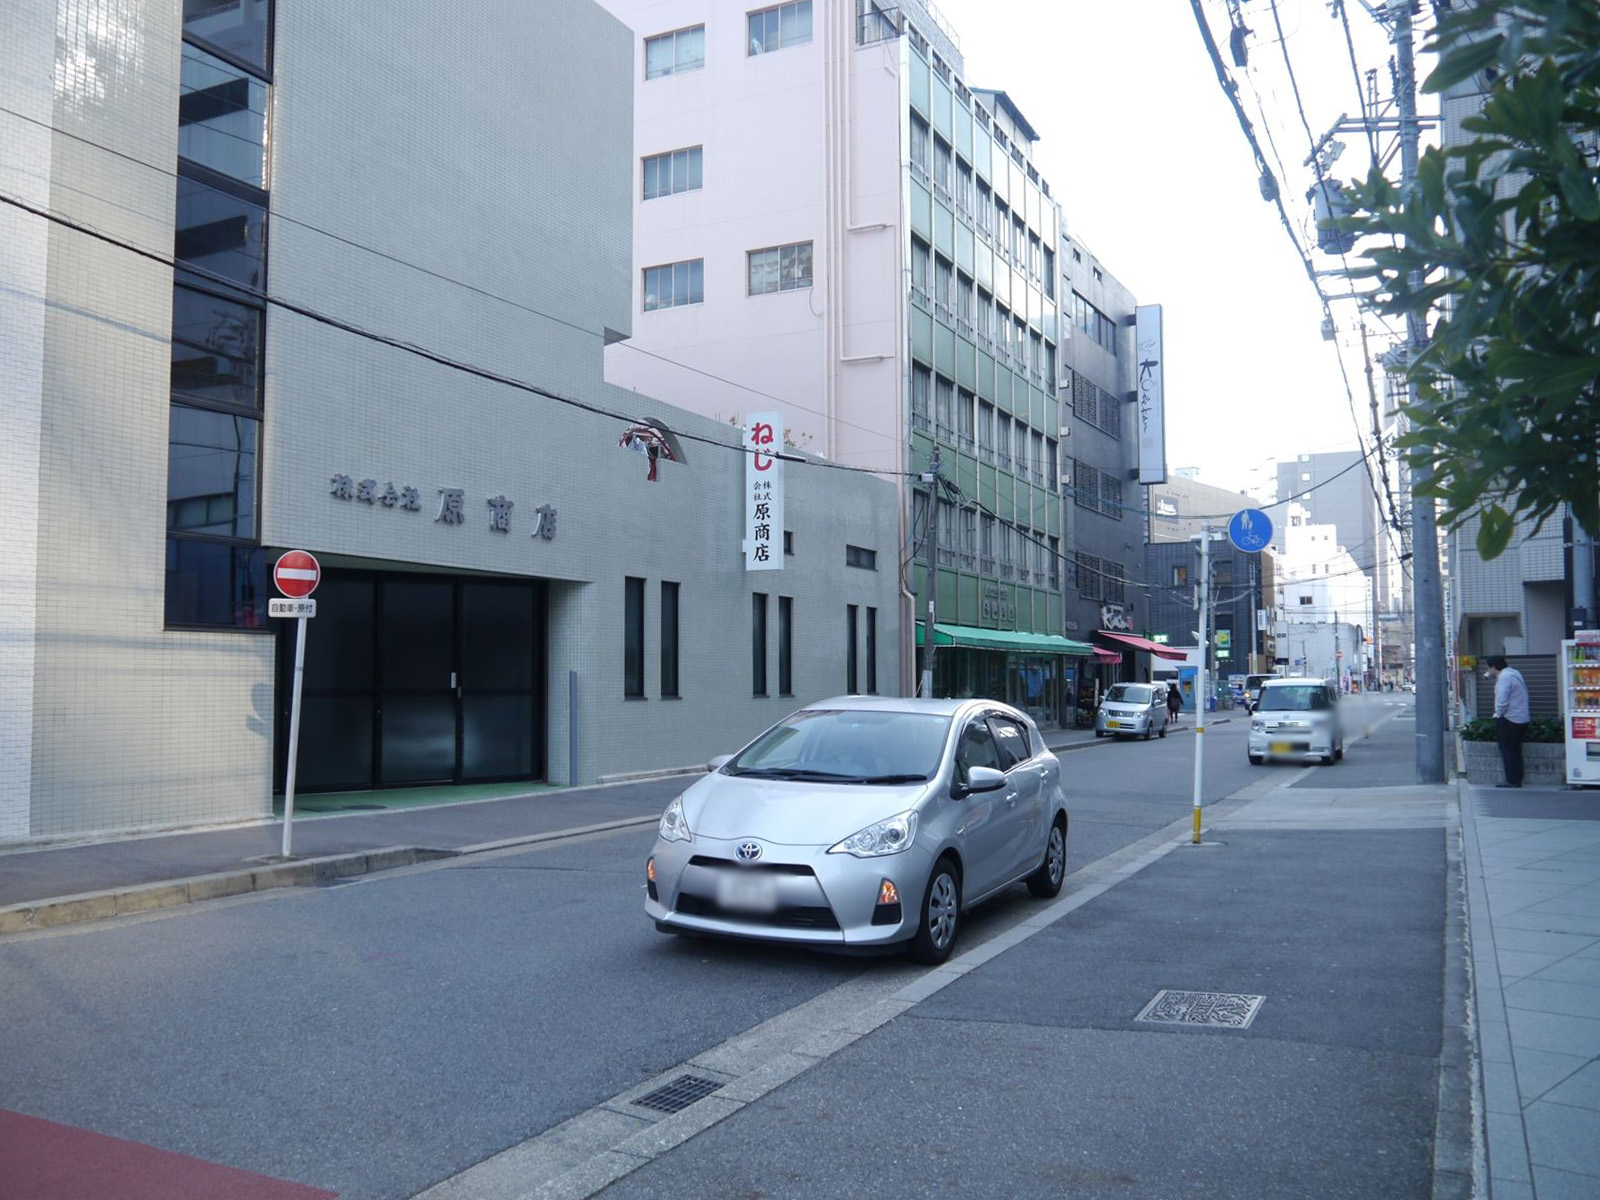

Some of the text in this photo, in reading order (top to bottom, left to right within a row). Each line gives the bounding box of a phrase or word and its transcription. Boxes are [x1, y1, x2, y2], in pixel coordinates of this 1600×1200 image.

[751, 422, 774, 472] ねじ
[753, 503, 771, 562] 原商店
